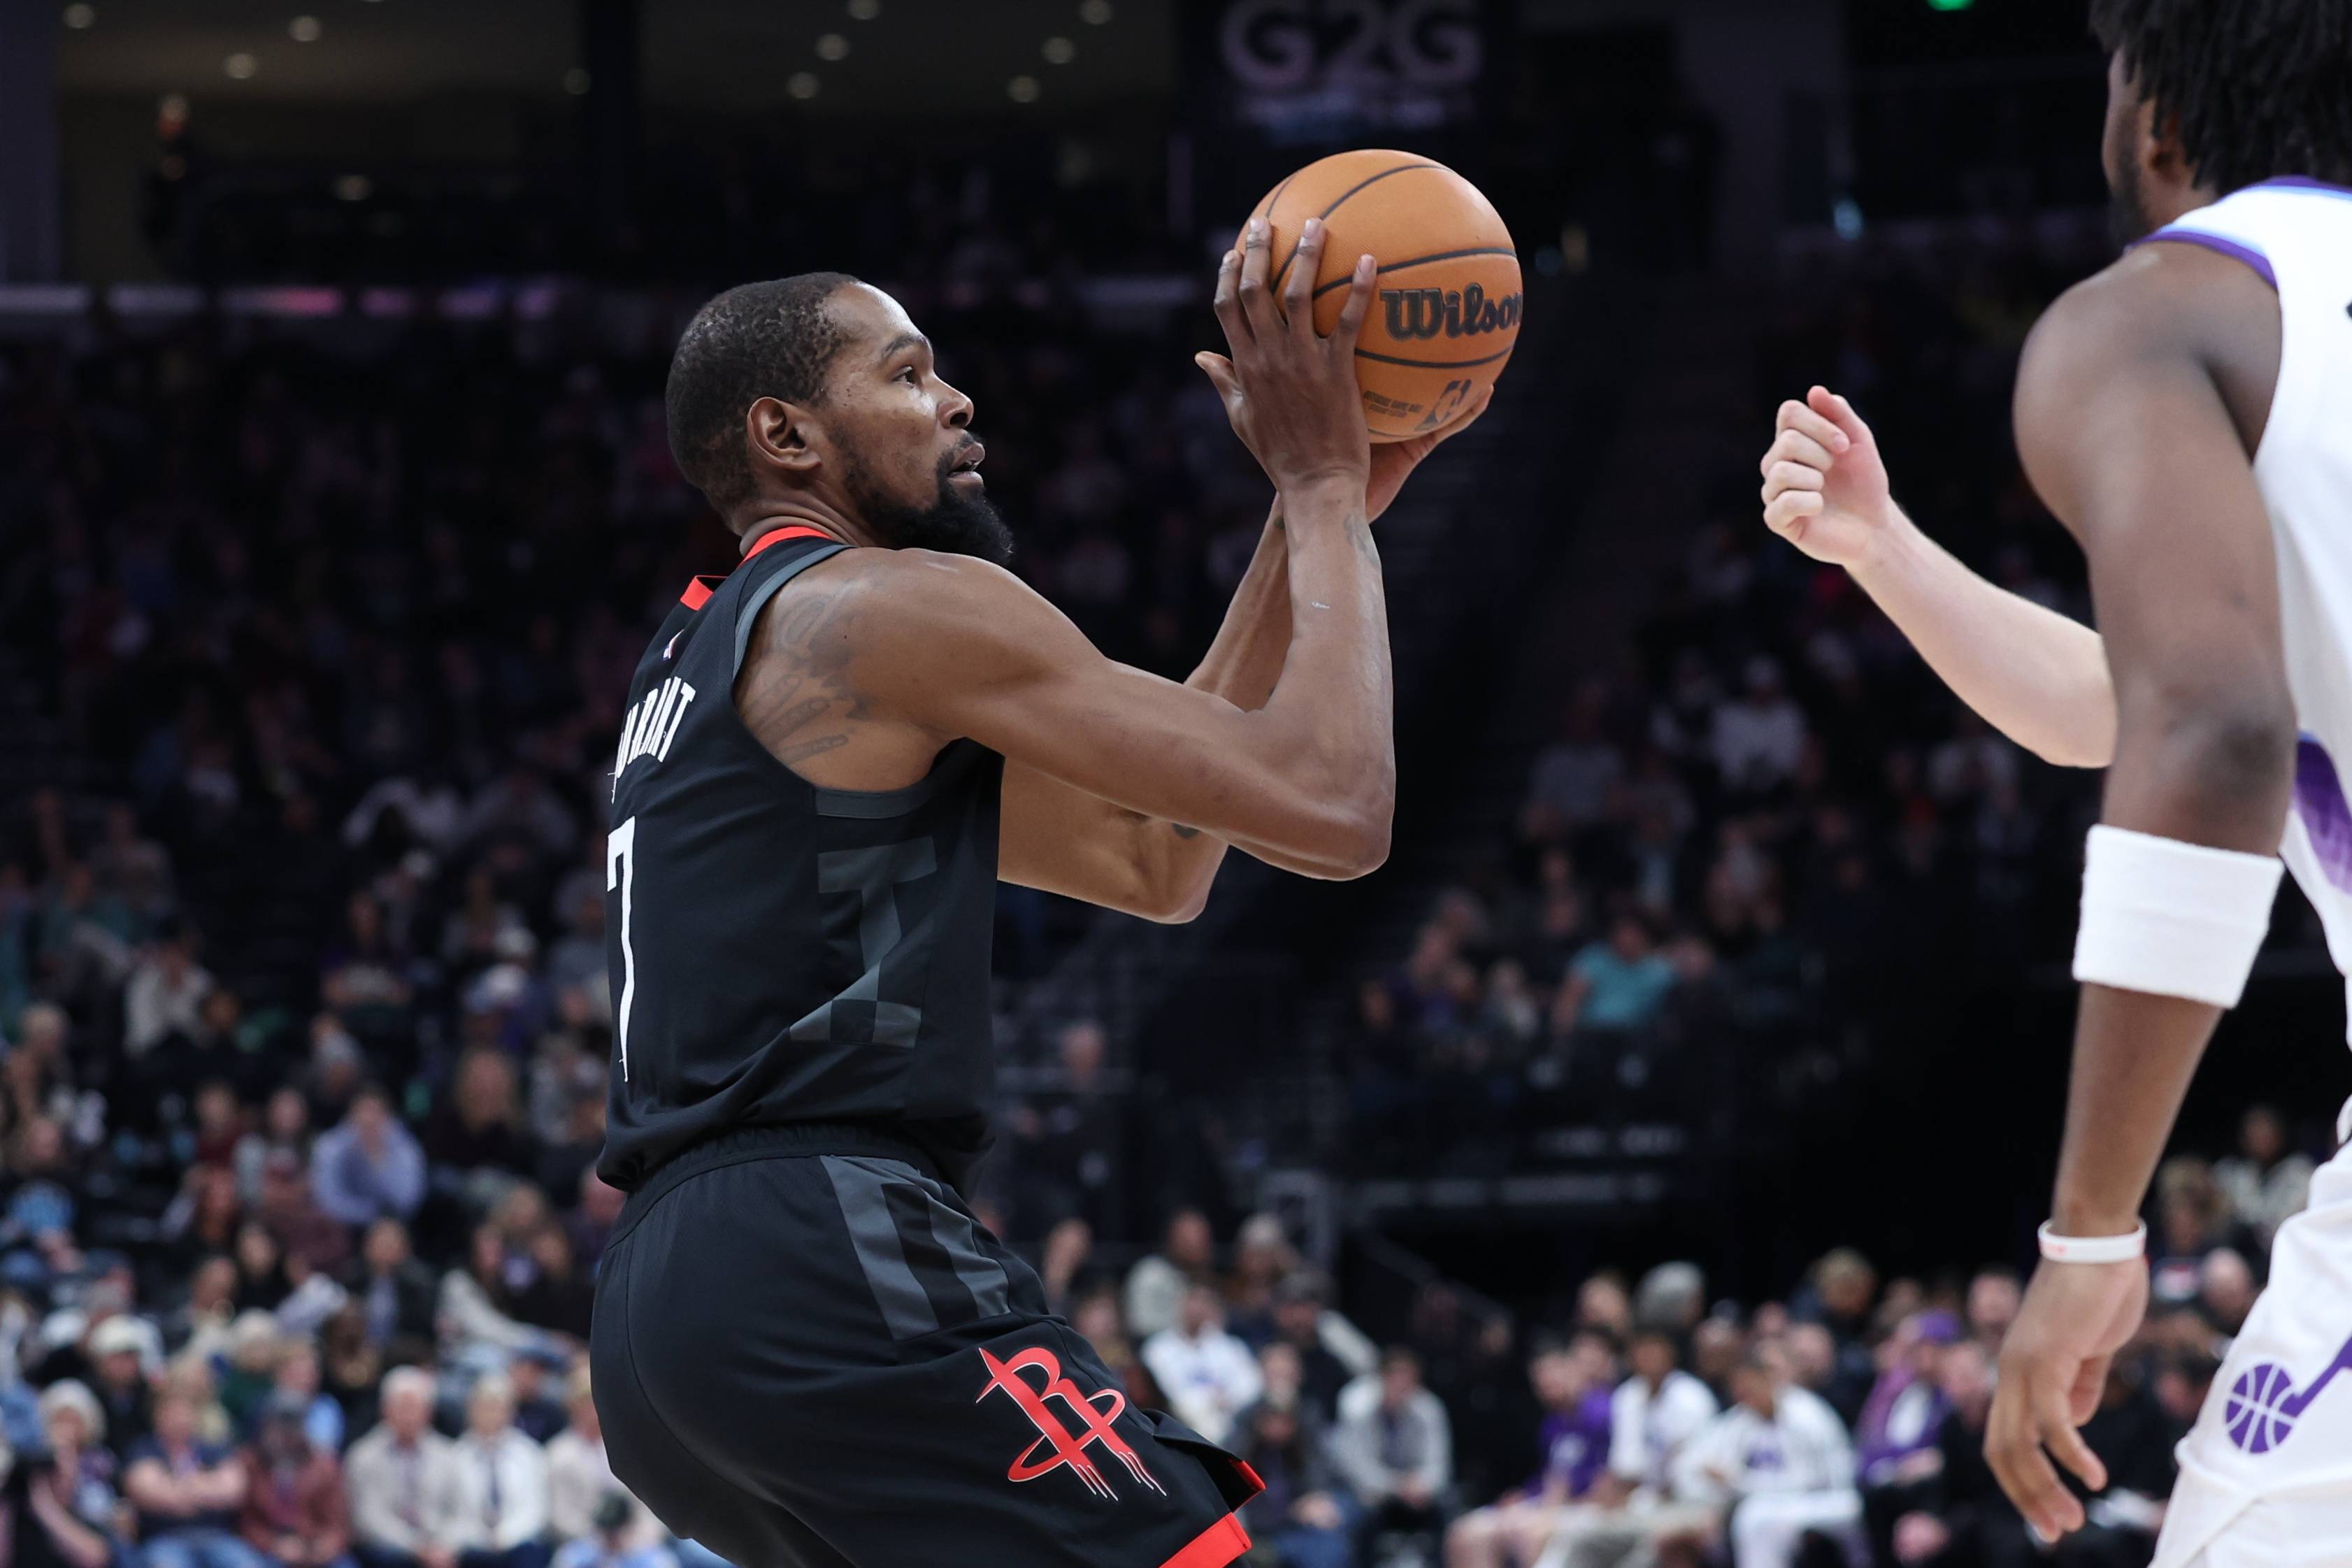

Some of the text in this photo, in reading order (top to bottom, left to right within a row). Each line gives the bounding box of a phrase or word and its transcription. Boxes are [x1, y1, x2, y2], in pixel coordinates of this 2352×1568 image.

[1219, 0, 1485, 87] G2G
[1379, 282, 1523, 341] Wilson
[607, 816, 636, 1083] 7
